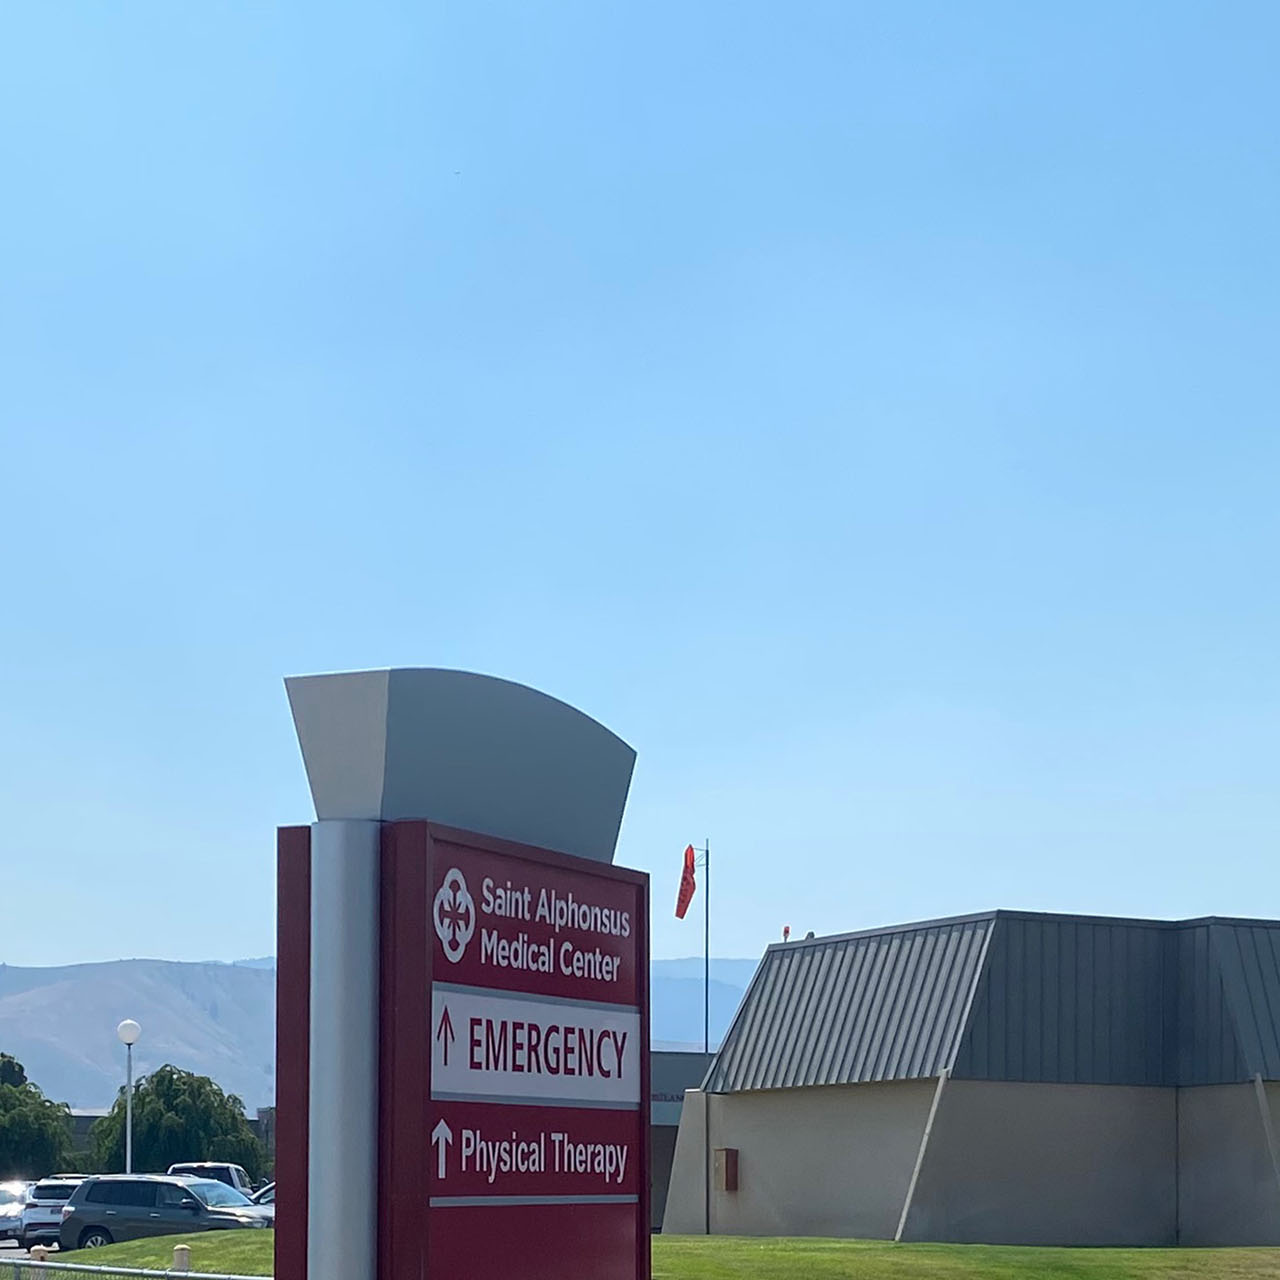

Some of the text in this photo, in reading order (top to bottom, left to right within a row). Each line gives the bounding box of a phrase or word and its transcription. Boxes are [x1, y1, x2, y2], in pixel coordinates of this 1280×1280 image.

[481, 877, 630, 938] Saint Alphonsus
[481, 928, 621, 982] Medical Center
[469, 1017, 628, 1079] EMERGENCY
[461, 1129, 628, 1184] Physical Therapy
